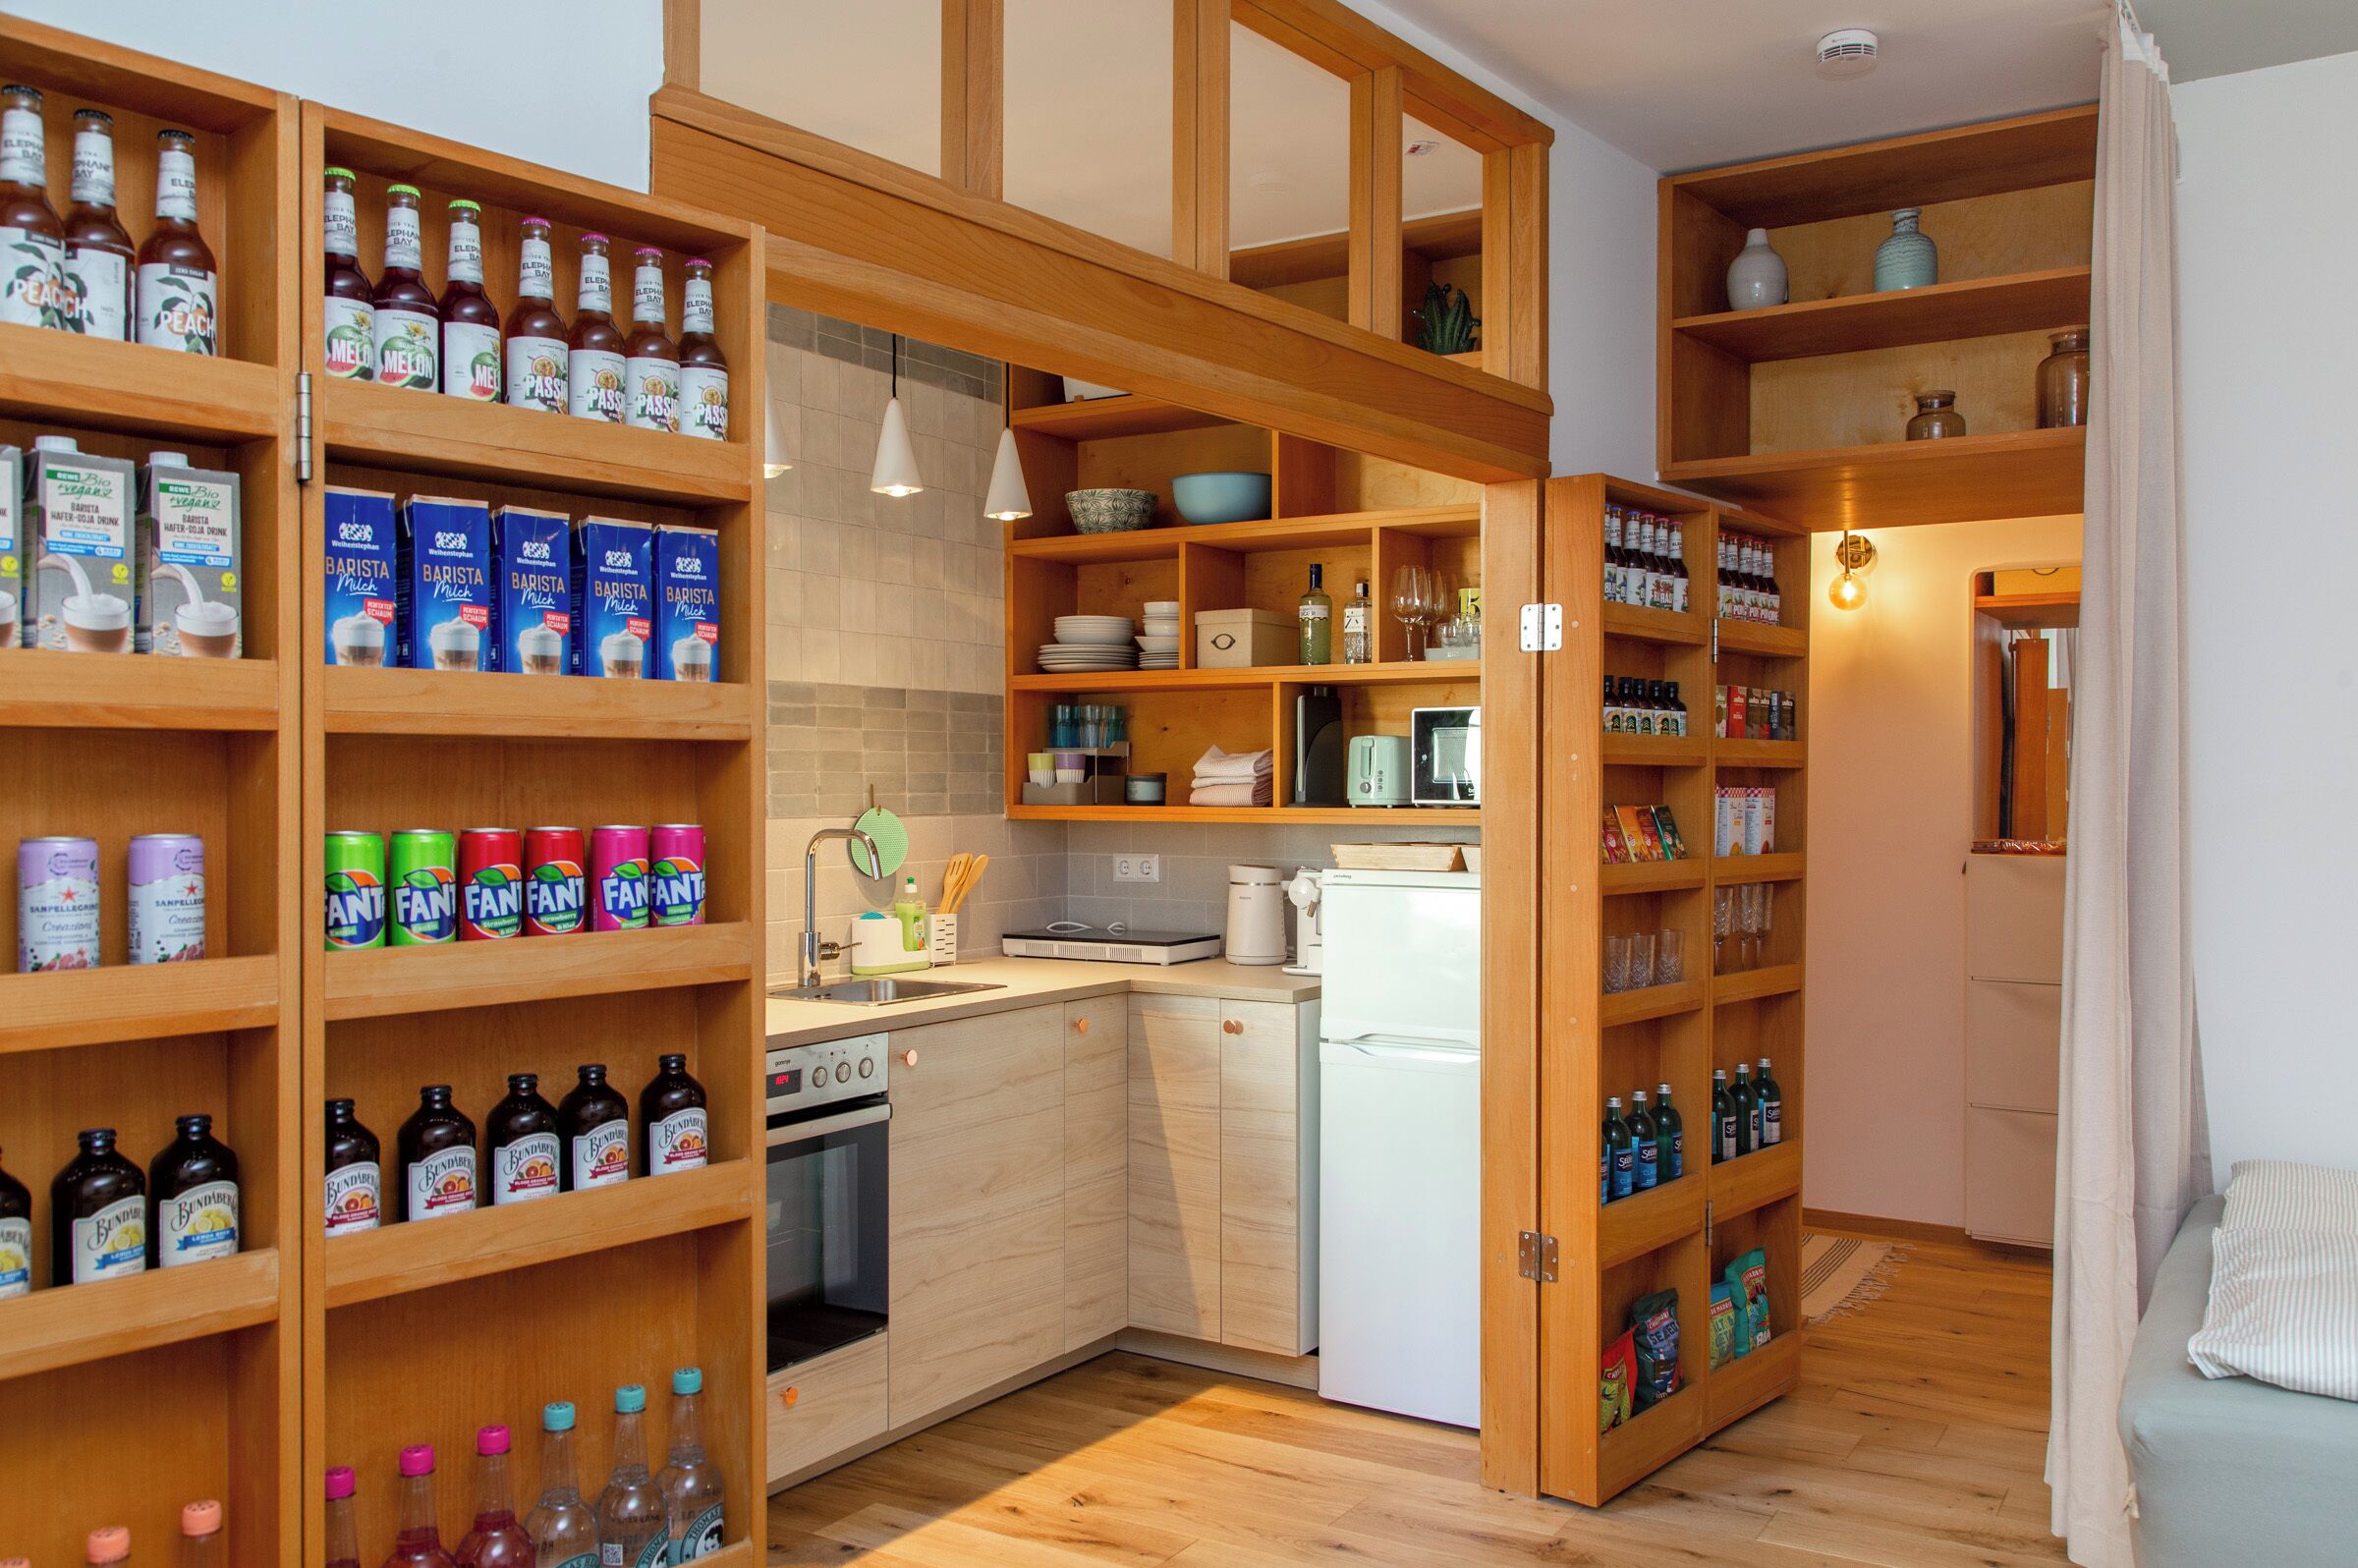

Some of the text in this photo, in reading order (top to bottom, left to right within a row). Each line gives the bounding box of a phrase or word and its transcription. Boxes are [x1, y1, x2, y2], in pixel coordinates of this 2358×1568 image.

[393, 238, 413, 247] BAY
[383, 349, 433, 379] MELON
[57, 472, 111, 487] REWE Bio
[168, 485, 219, 499] REWE Bio
[71, 502, 100, 514] BARISTA
[96, 515, 120, 527] DRINK
[182, 514, 209, 526] BARISTA
[206, 527, 228, 536] DRINK
[331, 539, 380, 551] Weihenstephan
[428, 548, 474, 559] Weihenstephan
[325, 556, 390, 580] BARISTA
[516, 556, 556, 567] Weihenstephan
[422, 564, 483, 586] BARISTA
[599, 565, 639, 576] Weihenstephan
[670, 571, 707, 581] Weihenstephan
[337, 574, 378, 592] Milch
[433, 581, 473, 598] Milch
[511, 572, 566, 593] BARISTA
[521, 588, 555, 606] Milch
[594, 581, 647, 600] BARISTA
[666, 586, 715, 605] BARISTA
[604, 595, 639, 612] Milch
[675, 600, 706, 618] Milch
[366, 608, 392, 618] SCHAUM
[463, 613, 487, 624] SCHAUM
[689, 1508, 720, 1540] THOMAS
